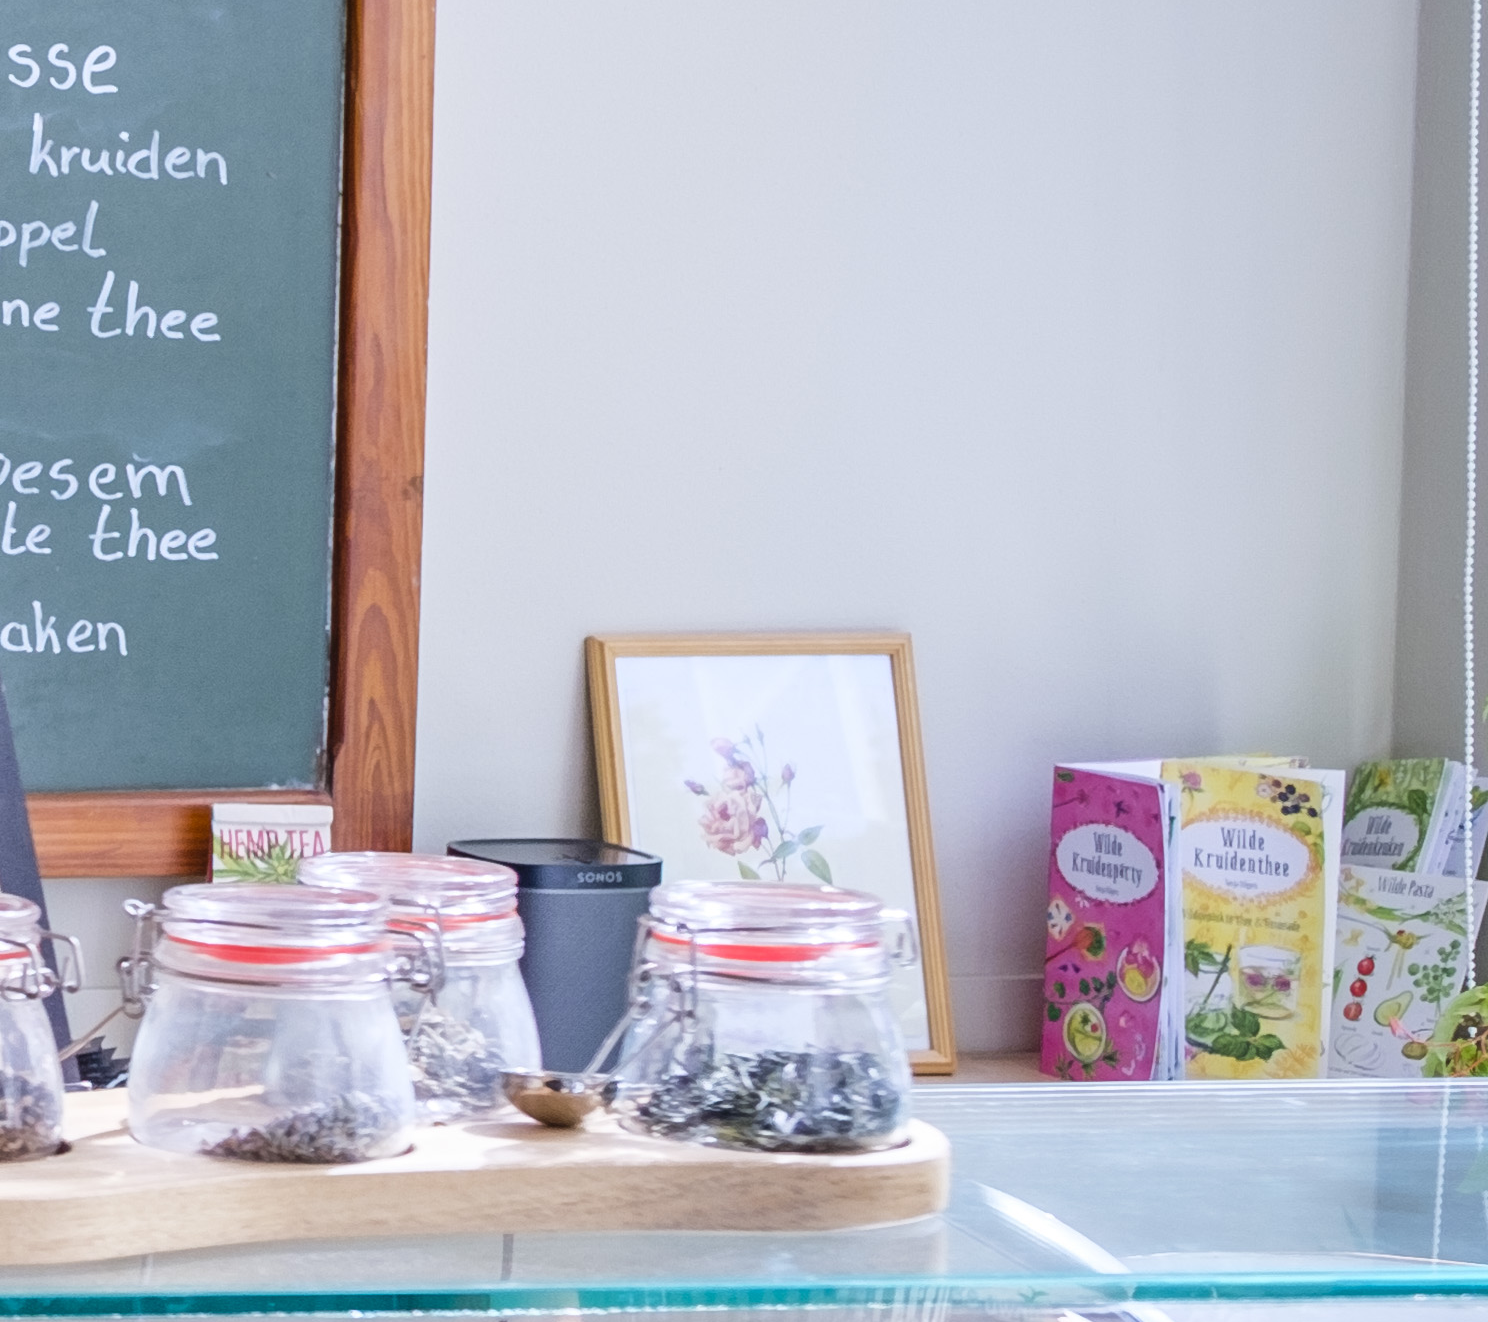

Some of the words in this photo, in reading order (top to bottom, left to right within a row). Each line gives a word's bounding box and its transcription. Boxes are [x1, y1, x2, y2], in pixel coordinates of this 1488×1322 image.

[29, 111, 228, 186] kruiden
[86, 269, 223, 342] thee
[88, 503, 220, 563] thee
[220, 828, 279, 860] HEMP
[289, 829, 326, 859] TEA
[1093, 830, 1123, 857] Wilde
[1221, 826, 1265, 852] Wilde
[576, 870, 624, 884] SONOS
[1071, 851, 1143, 889] Kruidenparty
[1193, 847, 1291, 878] Kruidenthee
[1378, 876, 1407, 895] Wilde
[1408, 879, 1435, 899] Pasta
